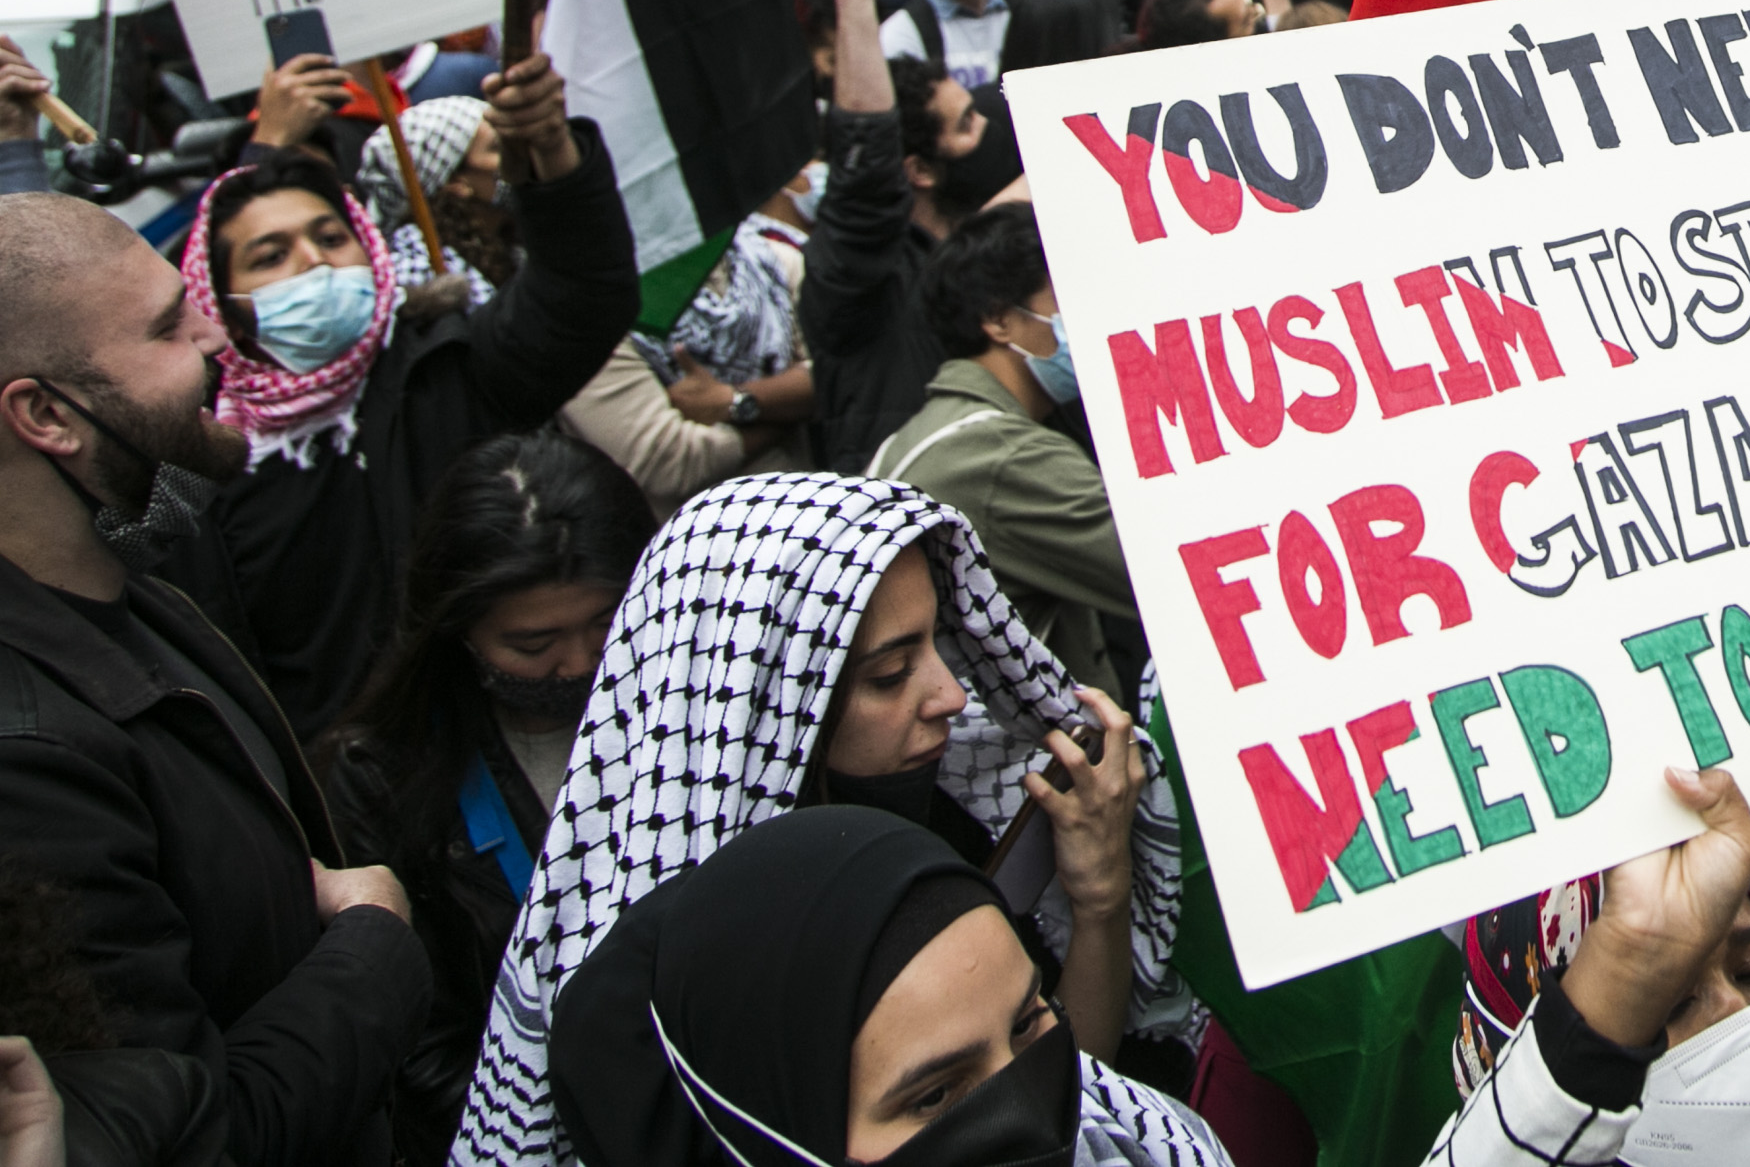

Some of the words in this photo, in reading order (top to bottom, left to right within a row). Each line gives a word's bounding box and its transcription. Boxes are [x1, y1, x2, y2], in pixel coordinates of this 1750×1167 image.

[1062, 81, 1329, 244] YOU
[1335, 23, 1622, 194] DON'T
[1107, 244, 1566, 480] MUSLIM
[1544, 228, 1679, 370] TO
[1178, 483, 1474, 693] FOR
[1237, 663, 1613, 914] NEED
[1650, 1131, 1676, 1142] KN95
